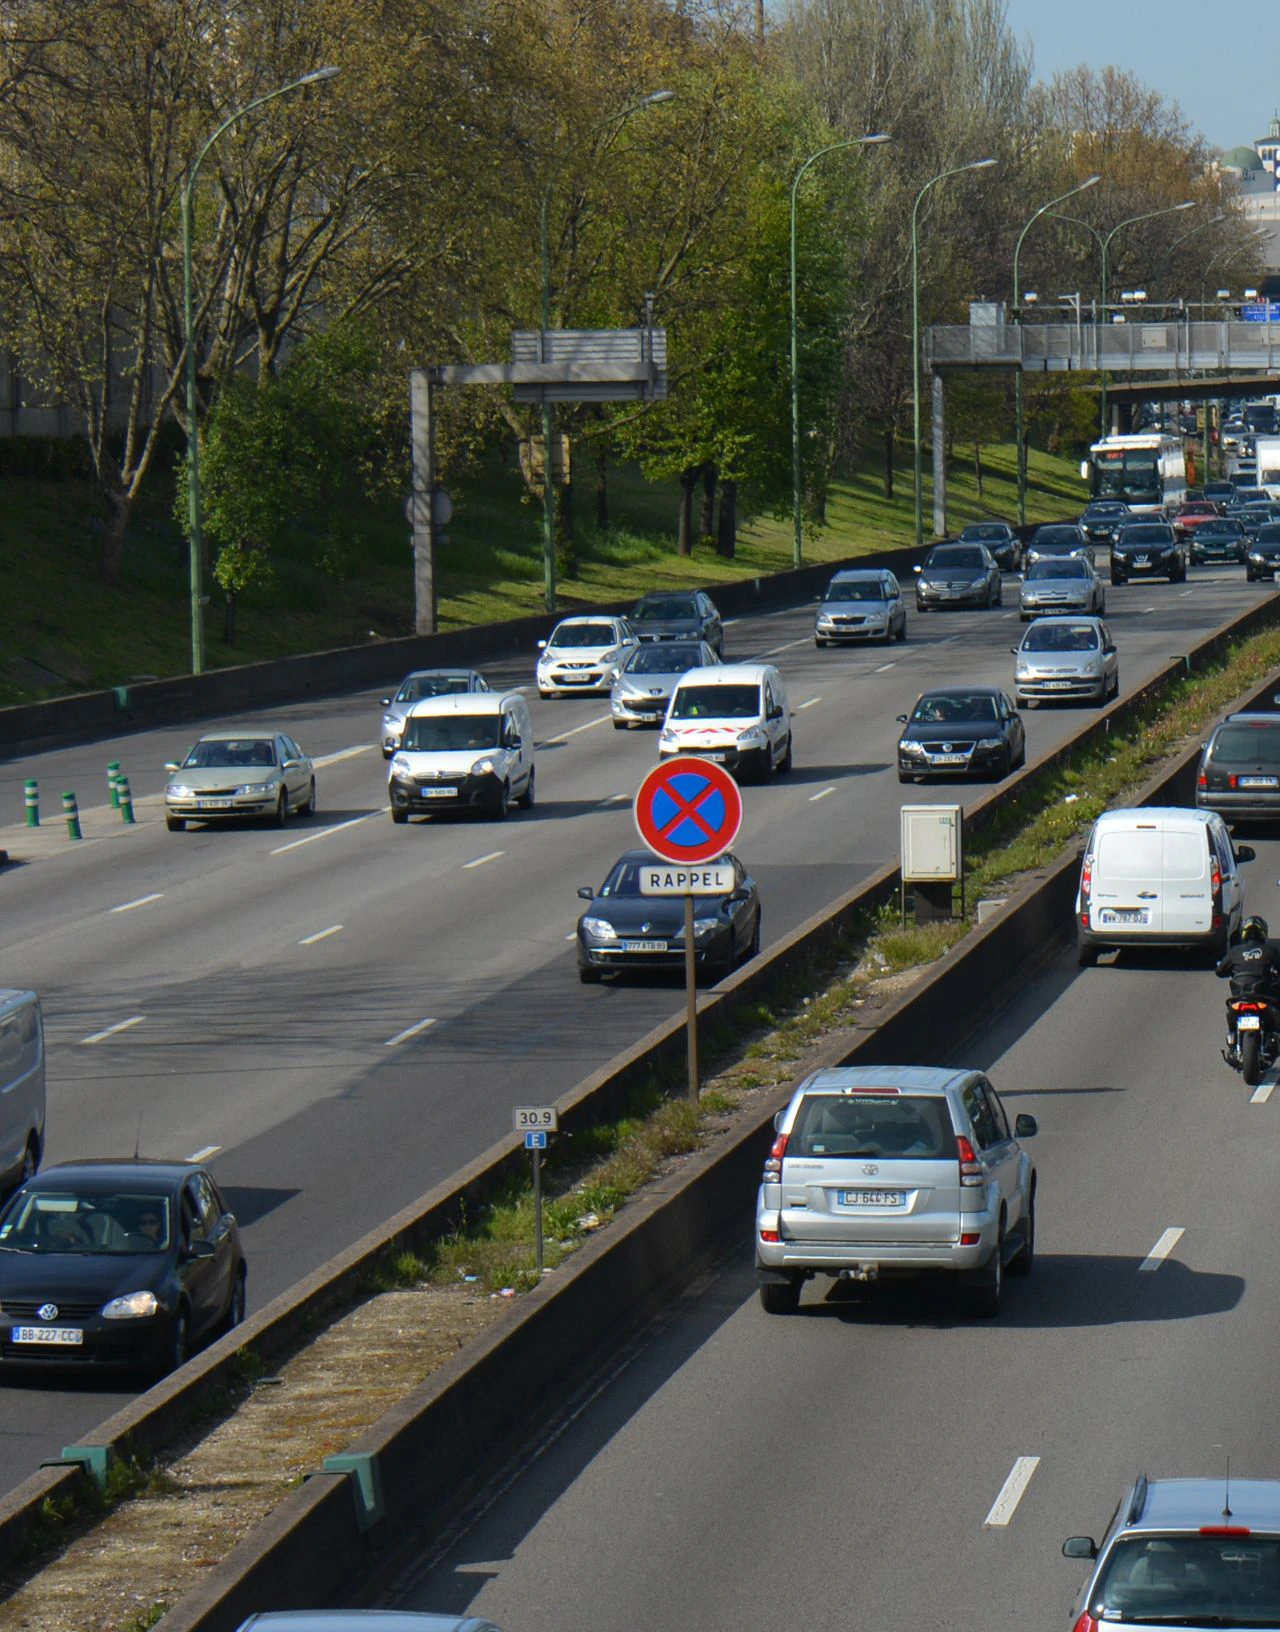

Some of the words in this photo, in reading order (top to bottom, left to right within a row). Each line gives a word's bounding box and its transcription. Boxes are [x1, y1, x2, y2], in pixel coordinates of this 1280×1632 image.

[650, 872, 724, 888] RAPPEL
[520, 1112, 552, 1125] 30.9
[532, 1133, 540, 1147] E
[21, 1327, 75, 1342] BB-227-CC
